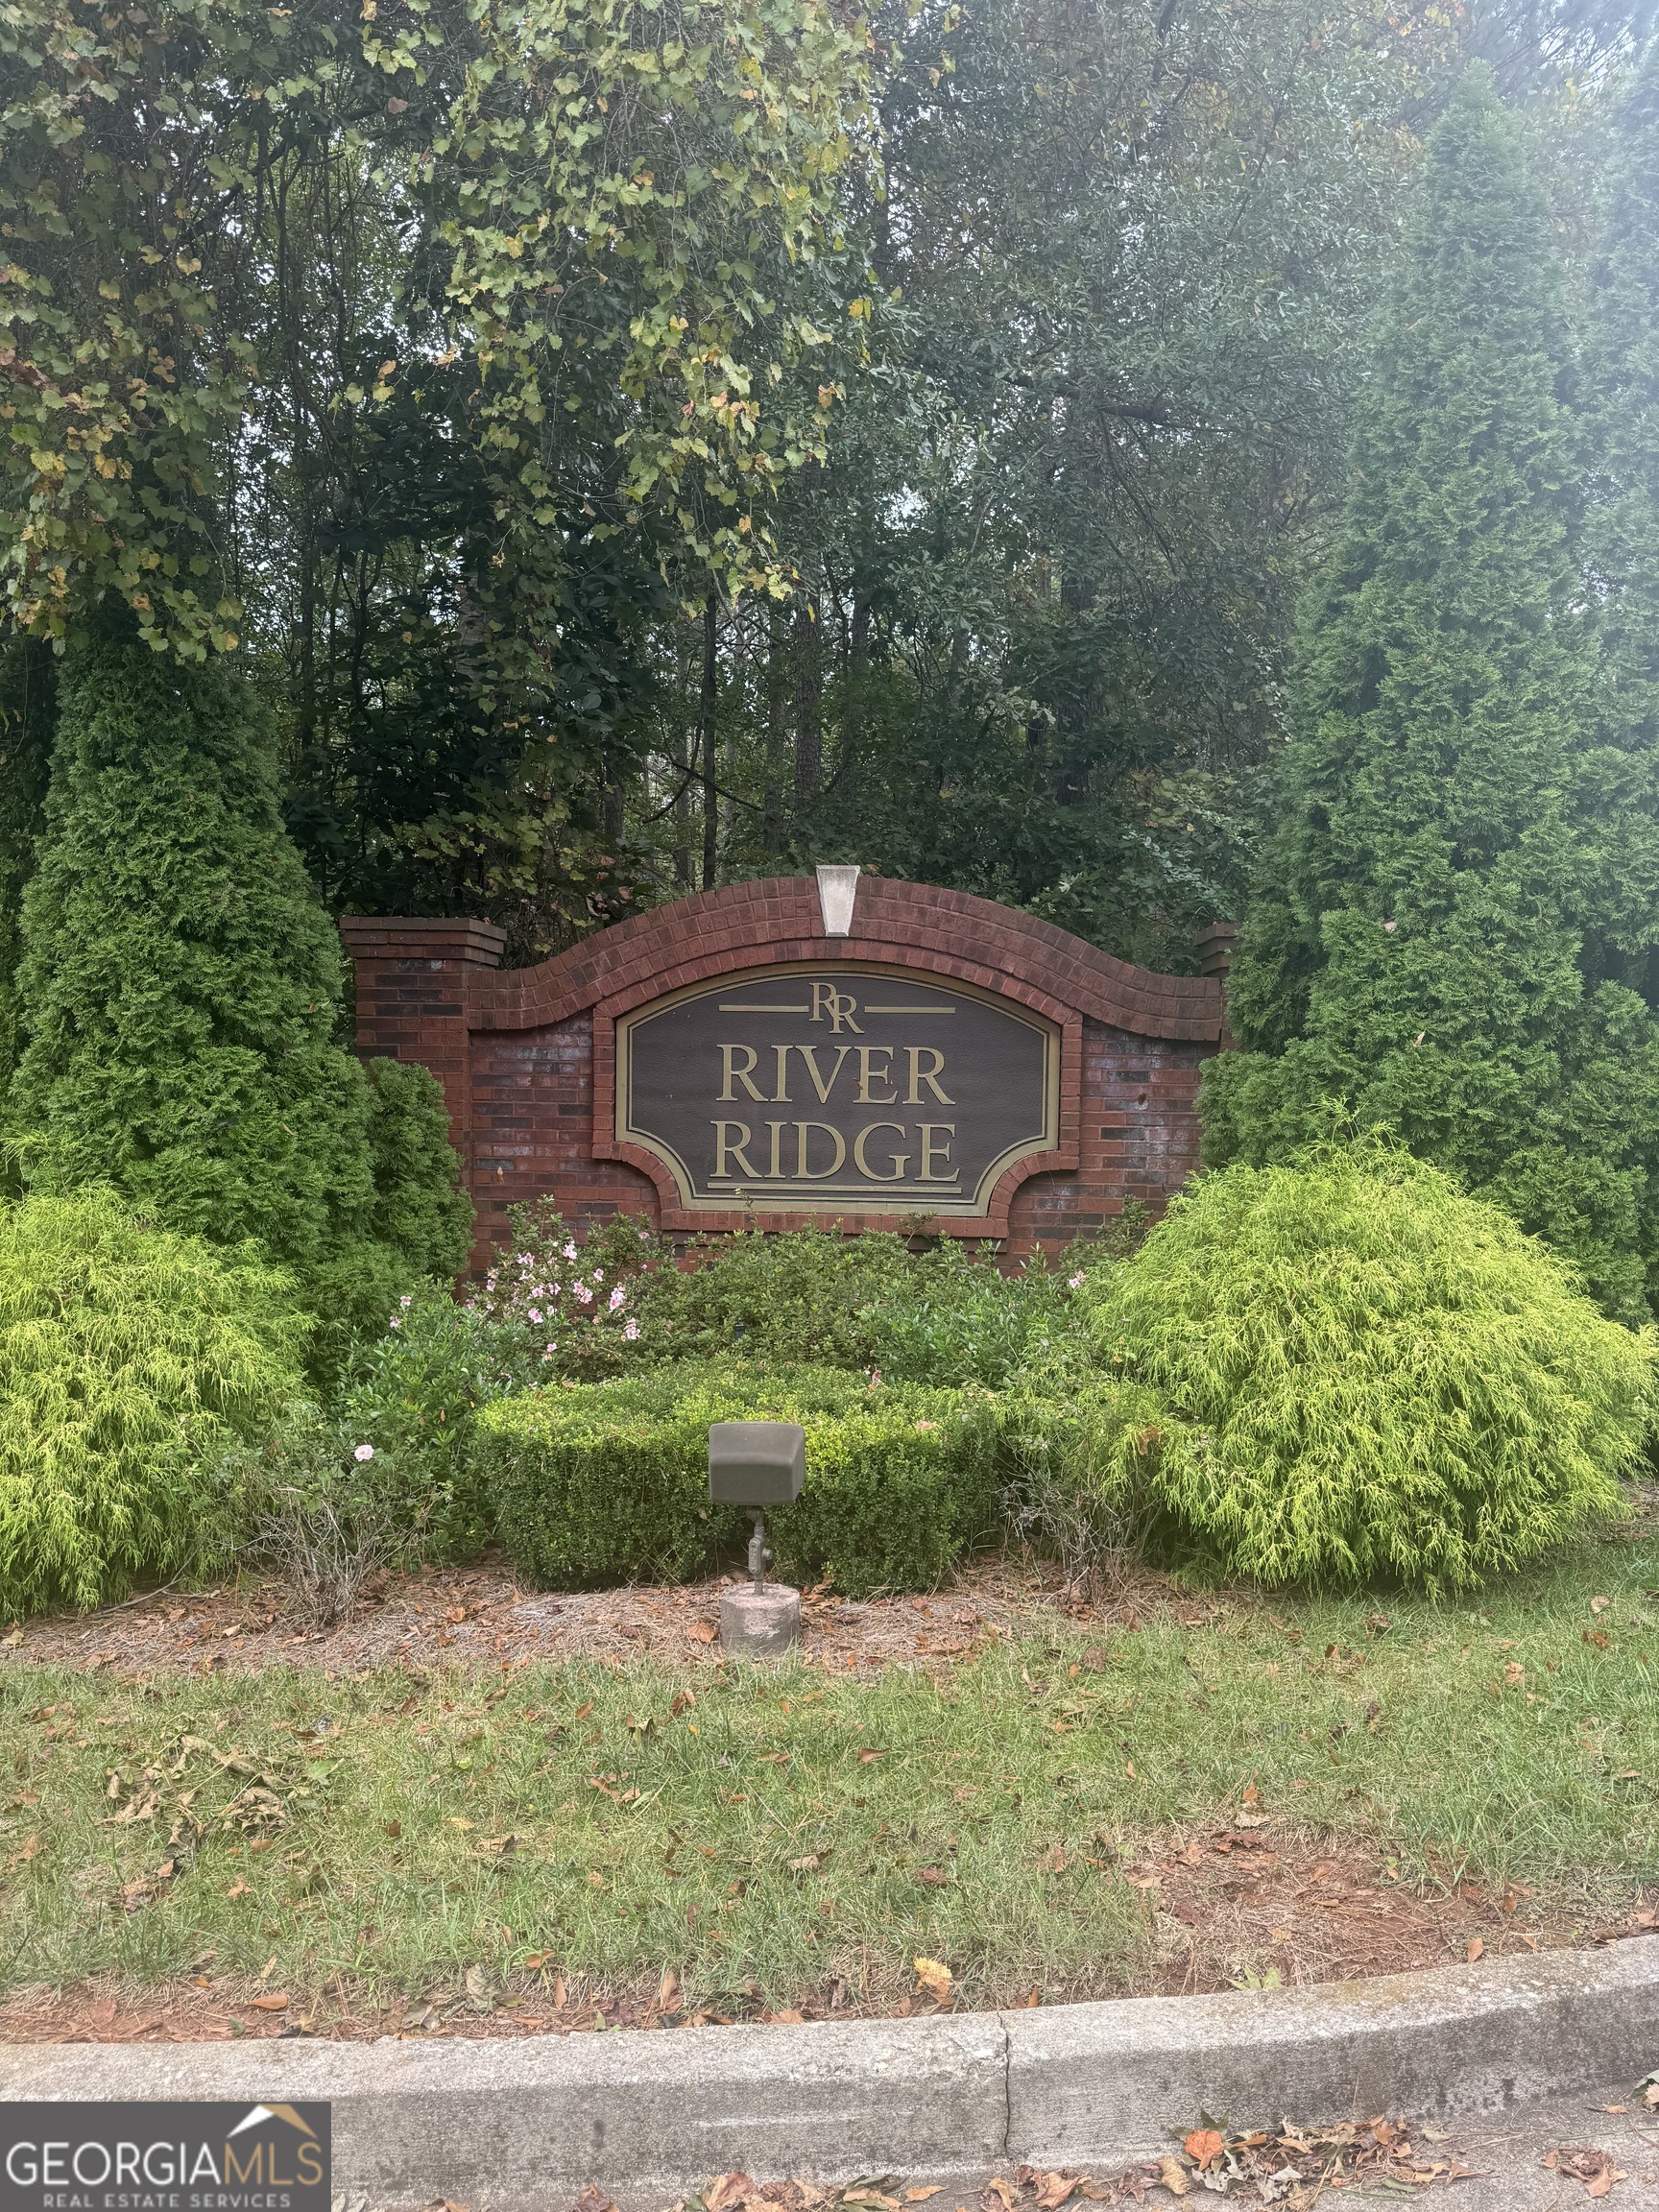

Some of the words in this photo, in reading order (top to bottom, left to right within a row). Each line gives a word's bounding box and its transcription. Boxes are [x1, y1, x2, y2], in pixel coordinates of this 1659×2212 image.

[808, 982, 865, 1034] RR
[715, 1044, 956, 1105] RIVER
[709, 1120, 960, 1182] RIDGE
